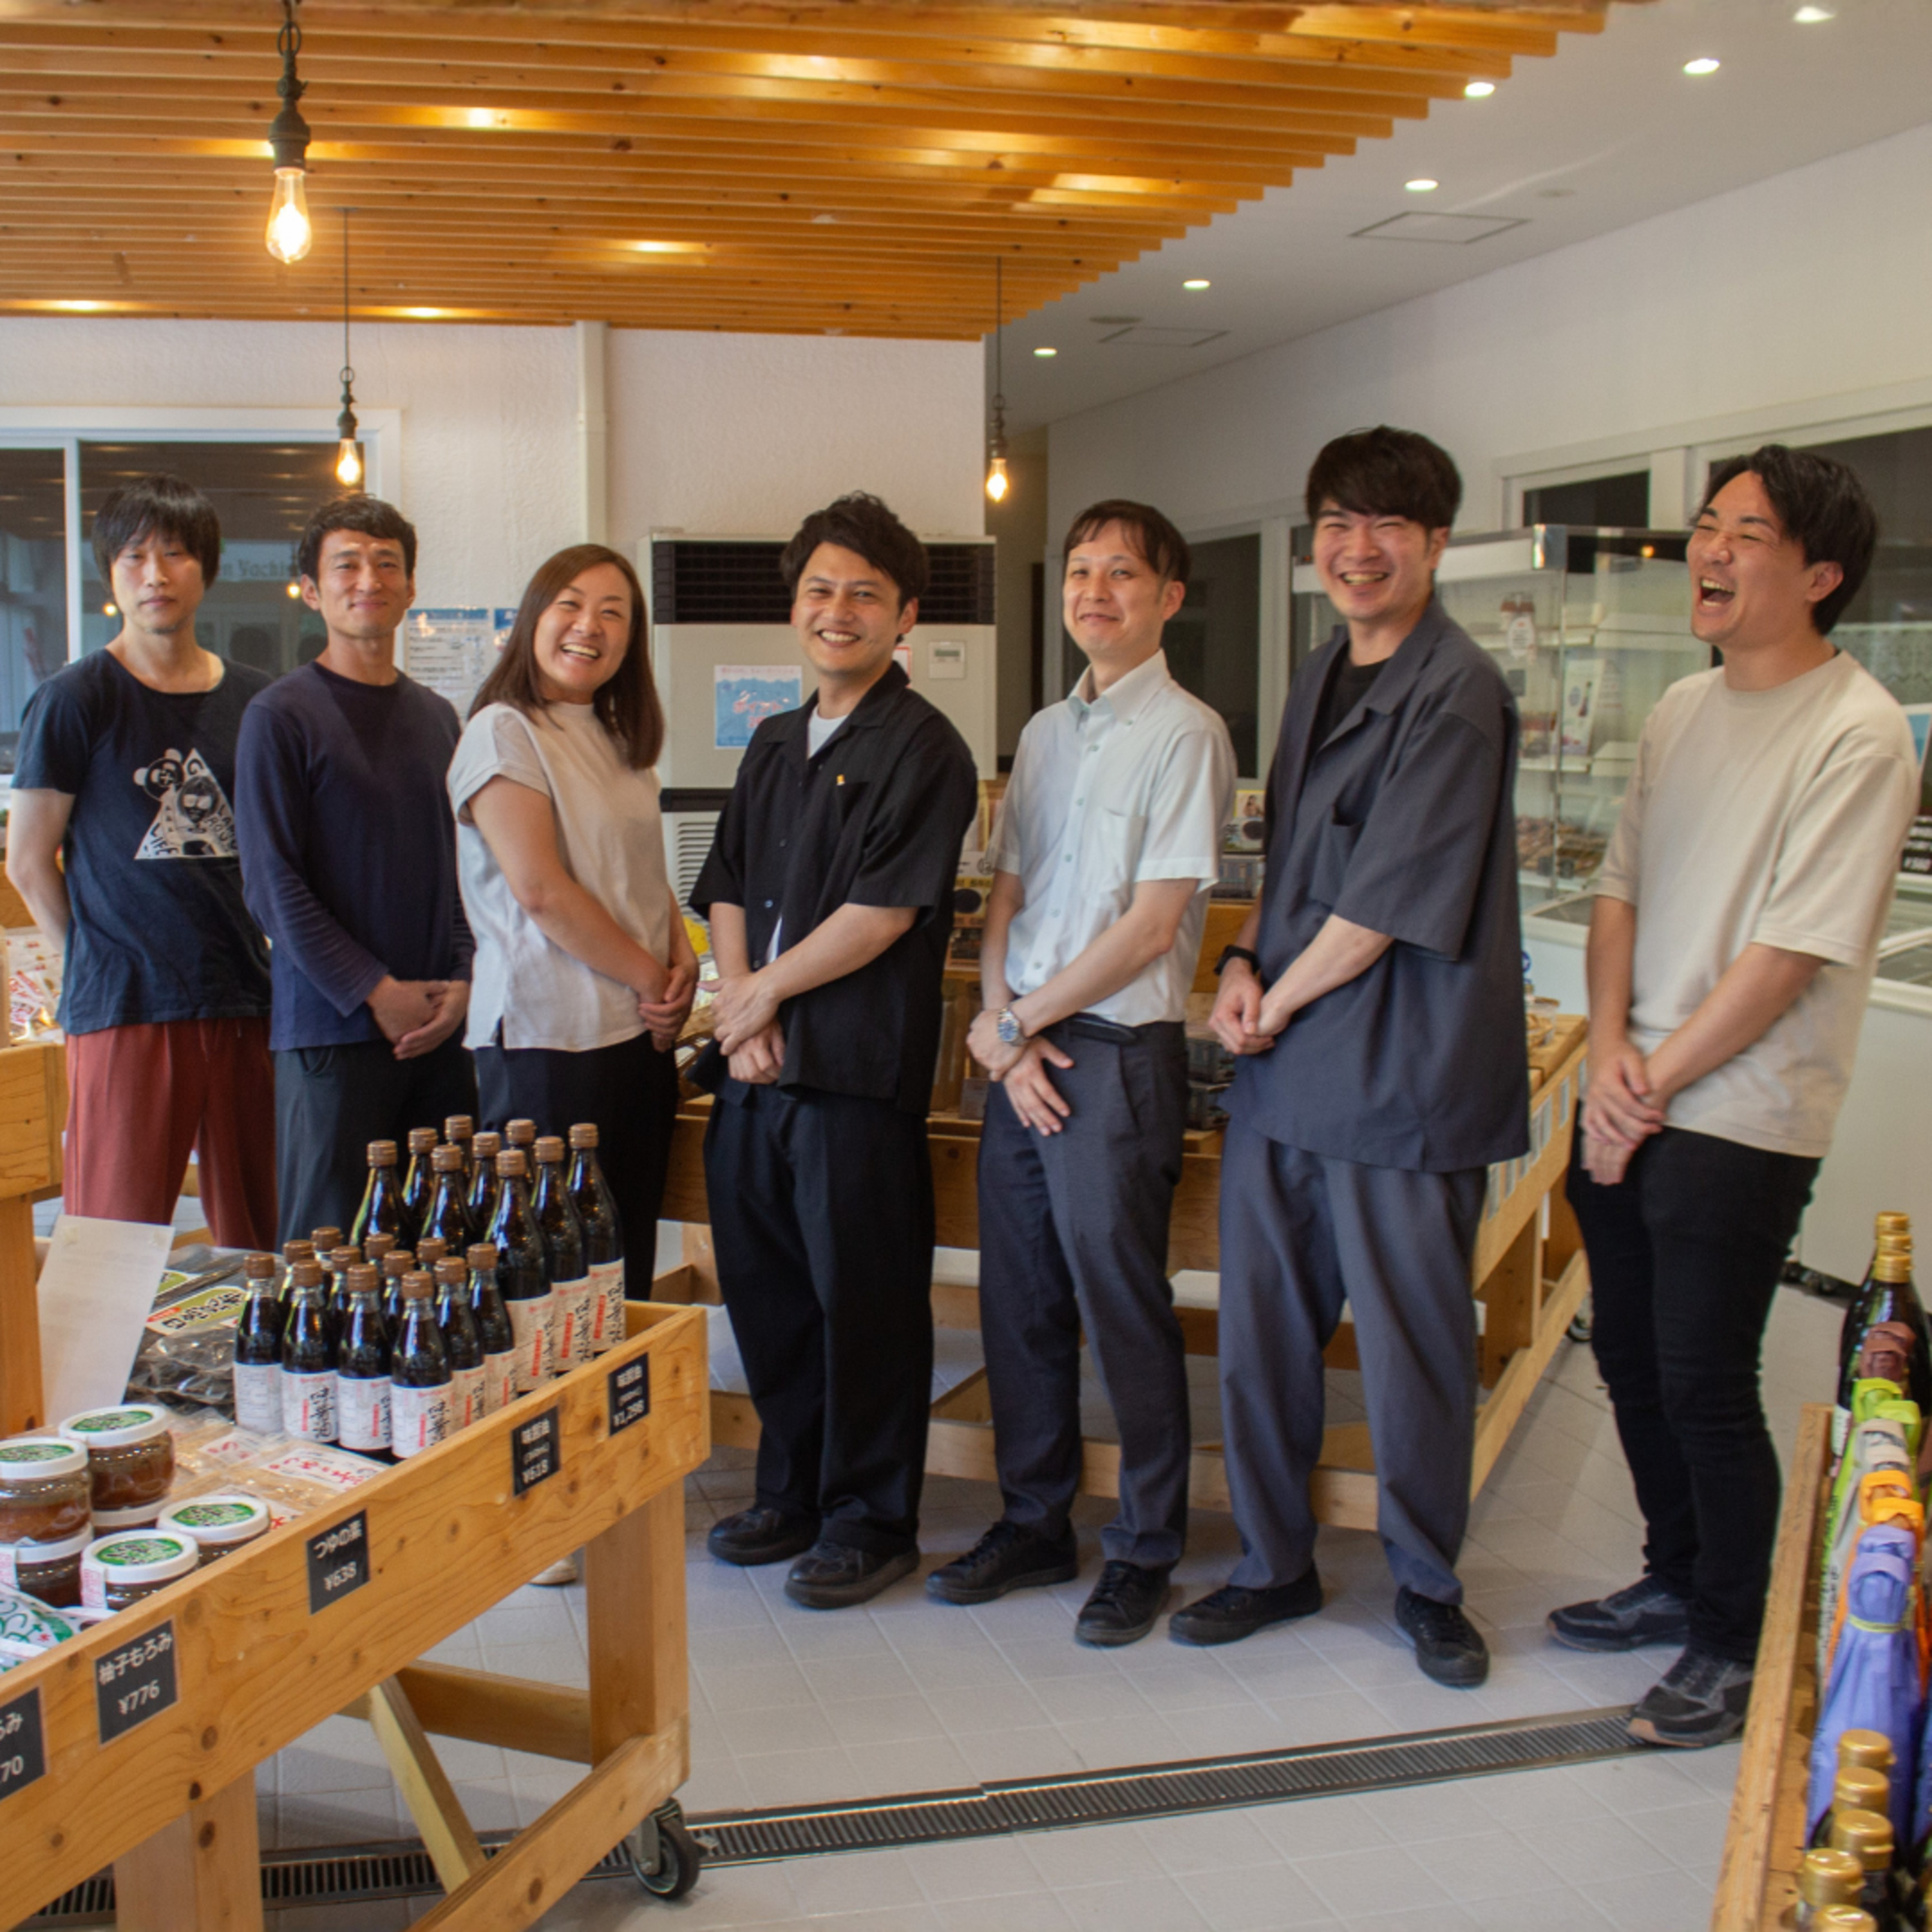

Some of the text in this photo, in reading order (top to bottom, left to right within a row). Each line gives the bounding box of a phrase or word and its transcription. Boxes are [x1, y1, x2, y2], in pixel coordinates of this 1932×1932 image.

[313, 1519, 363, 1558] つゆの素
[323, 1561, 357, 1591] ¥638
[99, 1632, 173, 1685] 柚子もろみ
[118, 1679, 160, 1716] ¥776
